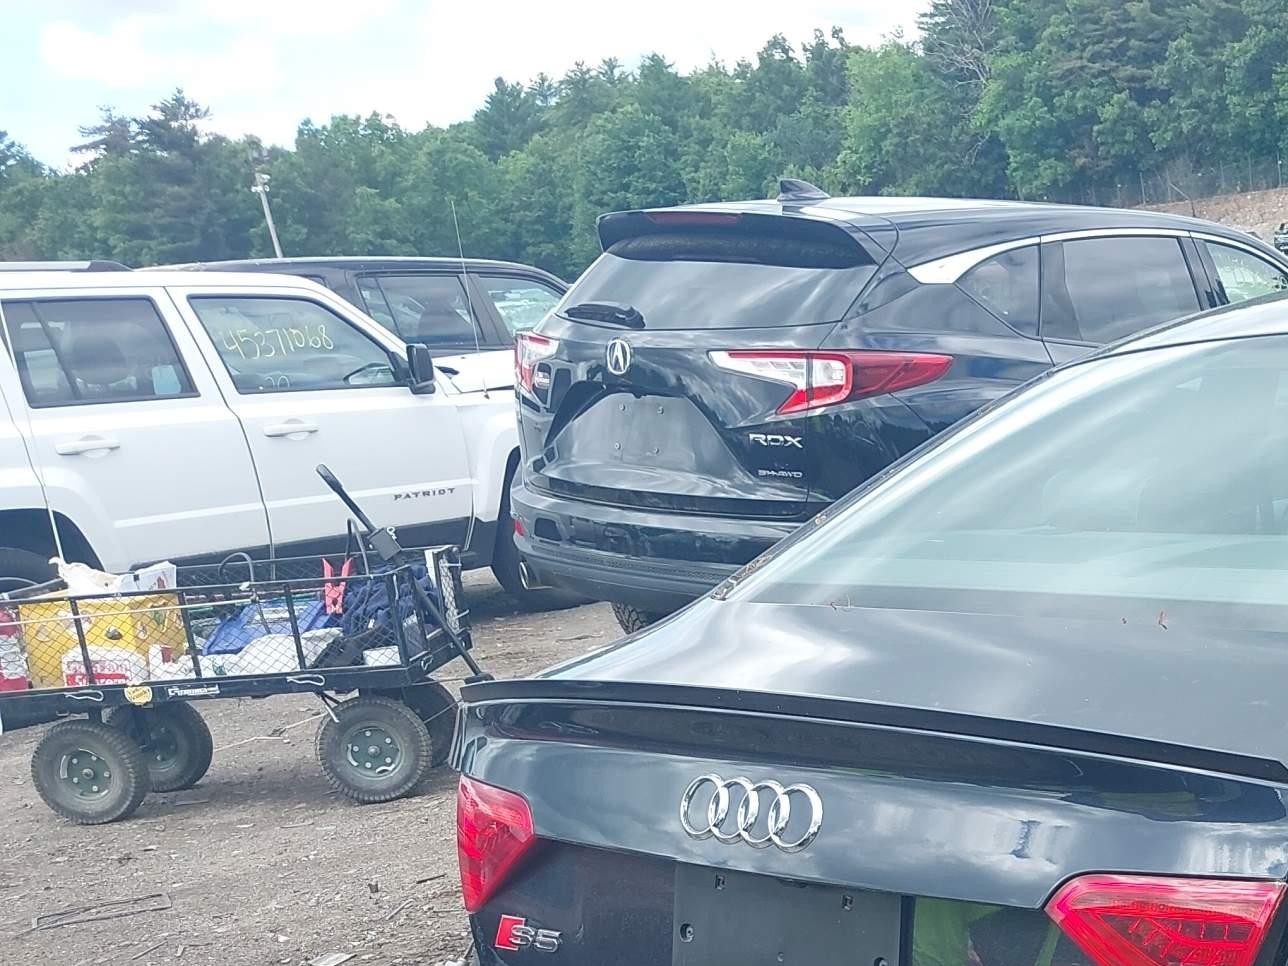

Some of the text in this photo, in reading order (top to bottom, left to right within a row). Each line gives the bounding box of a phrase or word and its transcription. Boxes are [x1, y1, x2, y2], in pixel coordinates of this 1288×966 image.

[223, 324, 334, 360] 45371068
[748, 433, 803, 448] RDX
[393, 487, 456, 501] PATRIOT
[507, 923, 562, 953] S5
